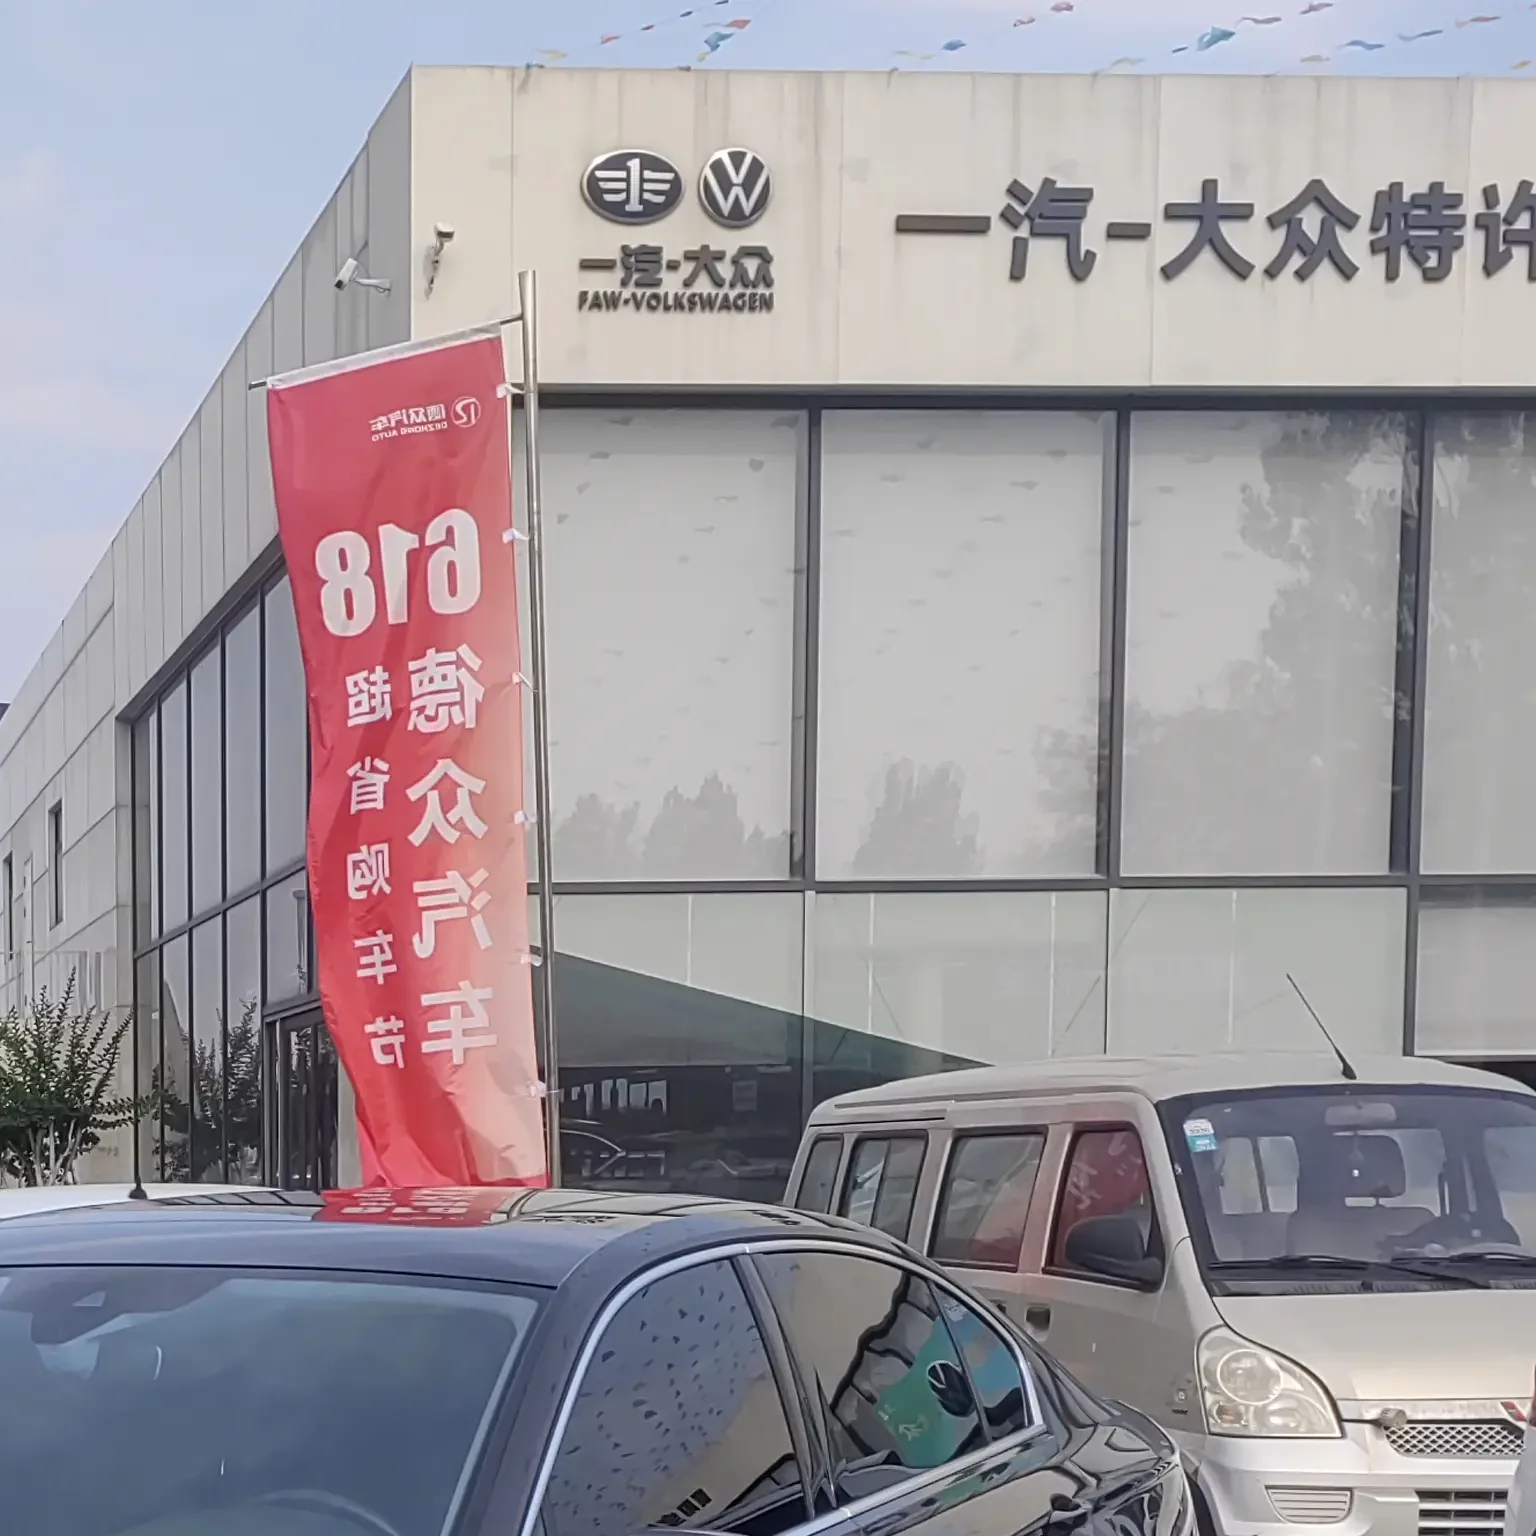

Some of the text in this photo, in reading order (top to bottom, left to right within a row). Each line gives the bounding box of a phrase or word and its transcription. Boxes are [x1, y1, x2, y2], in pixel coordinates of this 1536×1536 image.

[579, 244, 774, 288] 一汽-大众
[578, 290, 774, 313] FAW-VOLKSWAGEN
